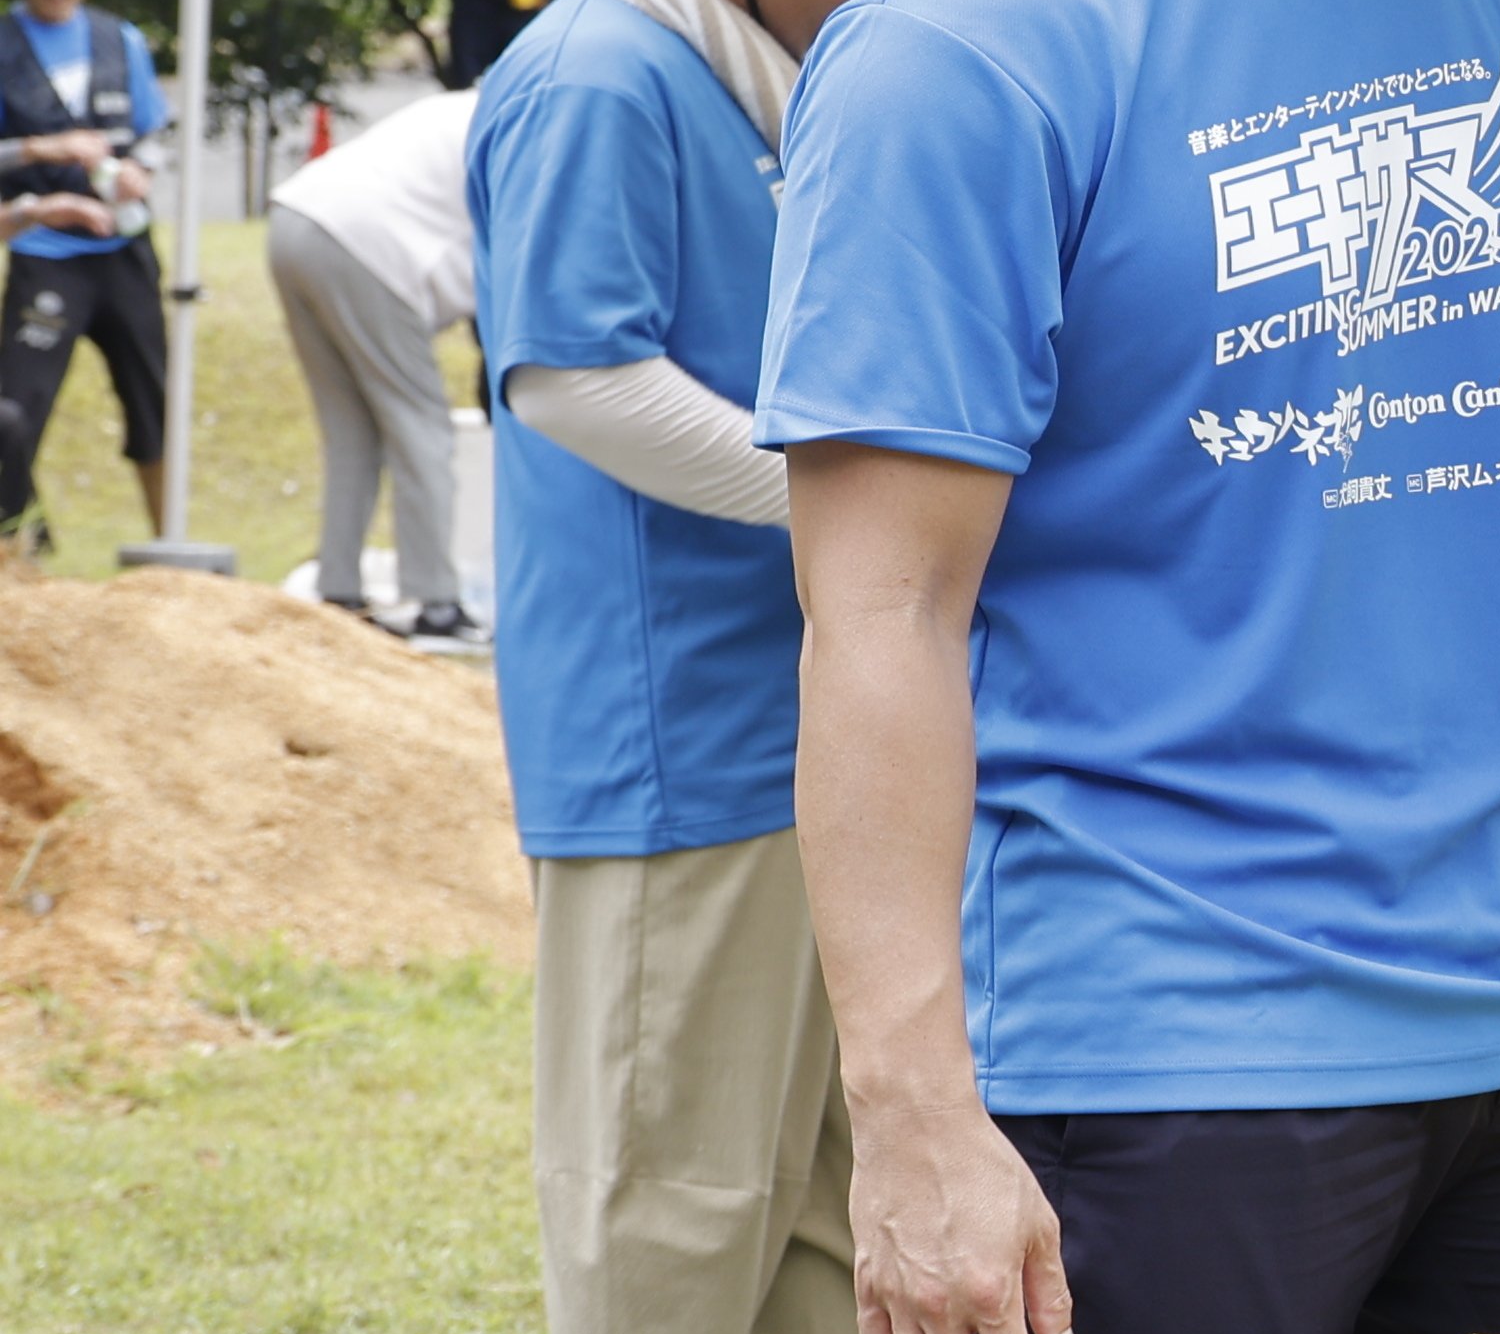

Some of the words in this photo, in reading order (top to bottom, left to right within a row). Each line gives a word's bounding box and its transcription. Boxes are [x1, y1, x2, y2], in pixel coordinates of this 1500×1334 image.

[1188, 58, 1492, 156] 音楽とエンターテインメントでひとつになる。
[1215, 289, 1362, 366] EXCITING
[1337, 294, 1437, 357] SUMMER
[1441, 298, 1463, 323] in
[1368, 391, 1446, 428] Conton
